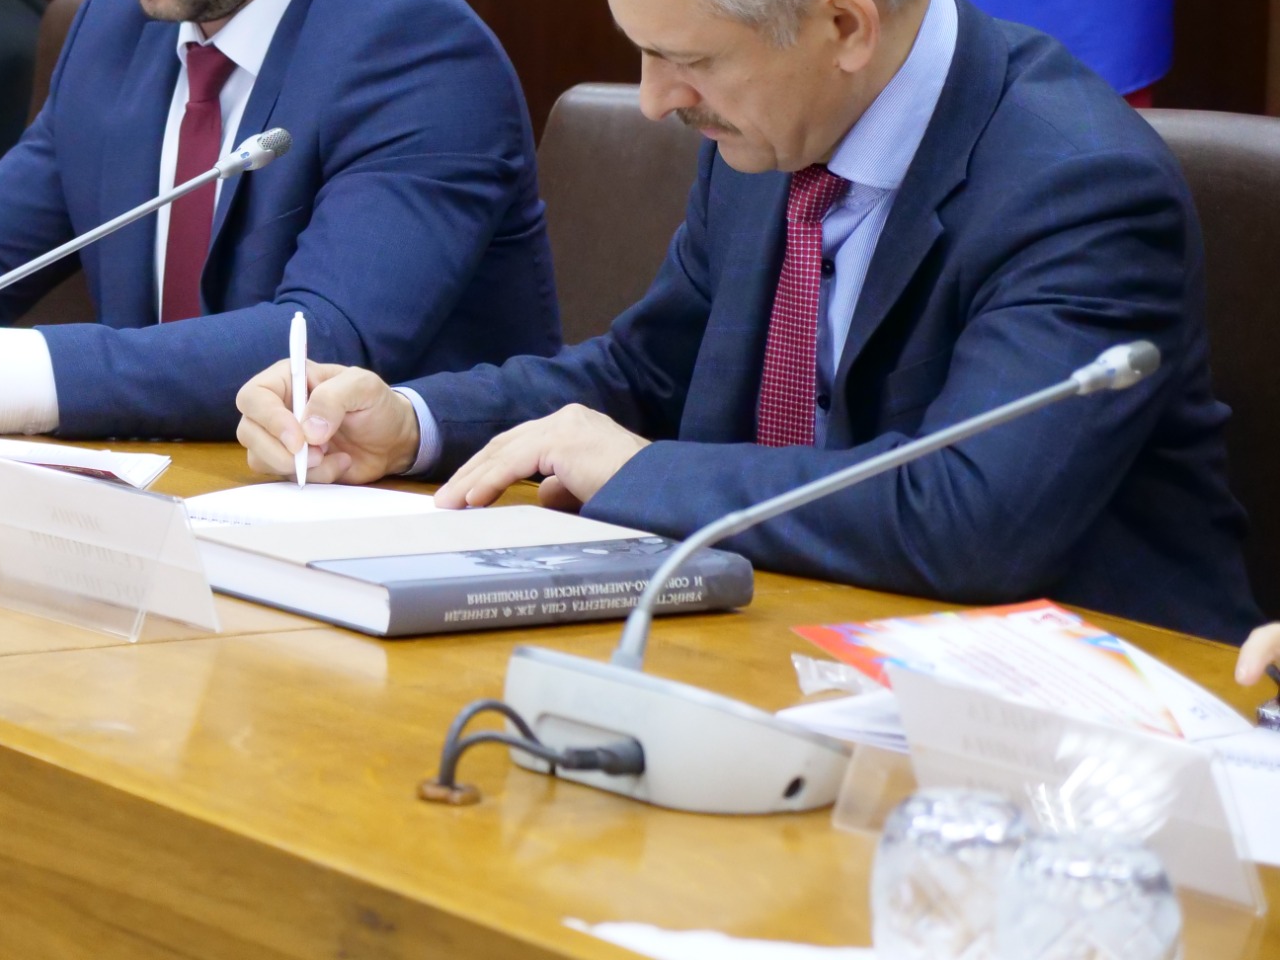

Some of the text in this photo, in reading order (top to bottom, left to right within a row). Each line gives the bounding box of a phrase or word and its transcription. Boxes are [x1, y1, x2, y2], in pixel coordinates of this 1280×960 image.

[693, 576, 703, 587] И
[466, 588, 539, 606] ОТНОШЕНИЯ
[444, 607, 498, 622] КЕННЕДИ
[541, 602, 567, 614] США
